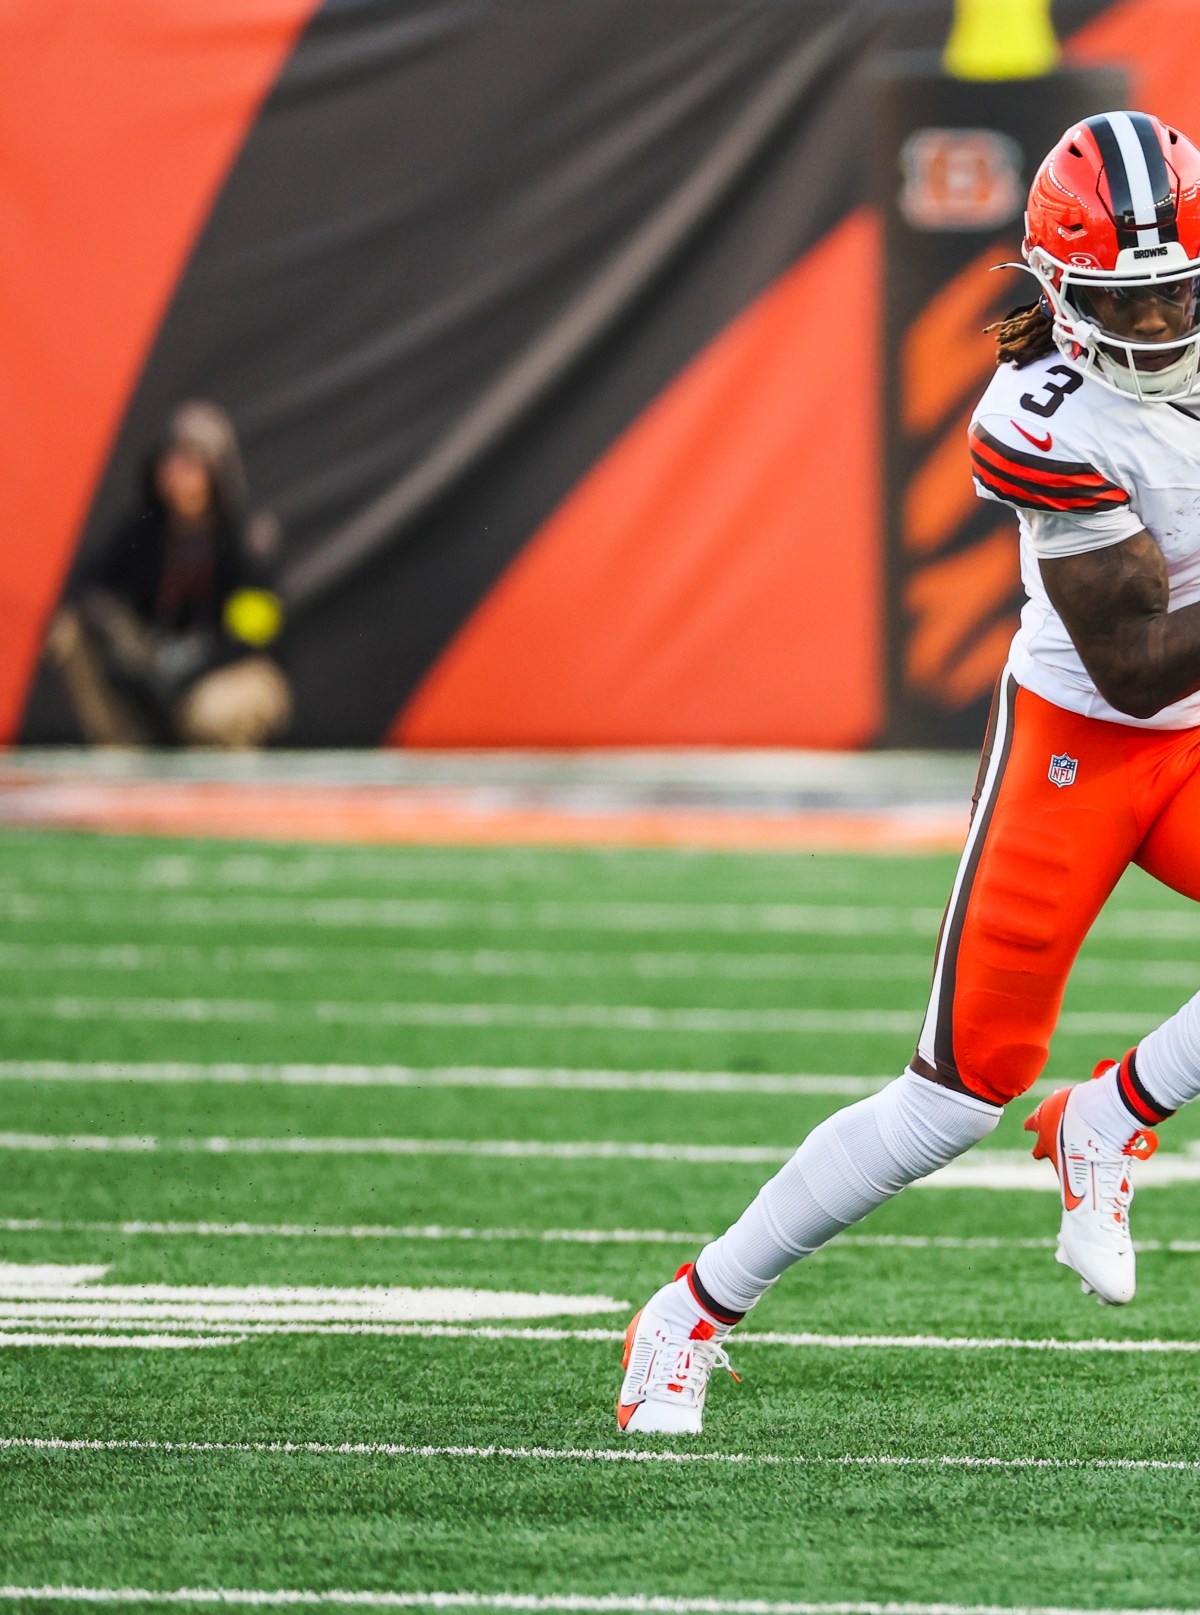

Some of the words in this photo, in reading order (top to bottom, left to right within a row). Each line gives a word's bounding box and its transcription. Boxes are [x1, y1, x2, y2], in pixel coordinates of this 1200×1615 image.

[1133, 246, 1168, 260] BROWNS
[1020, 365, 1083, 418] 3
[1053, 767, 1071, 781] NFL
